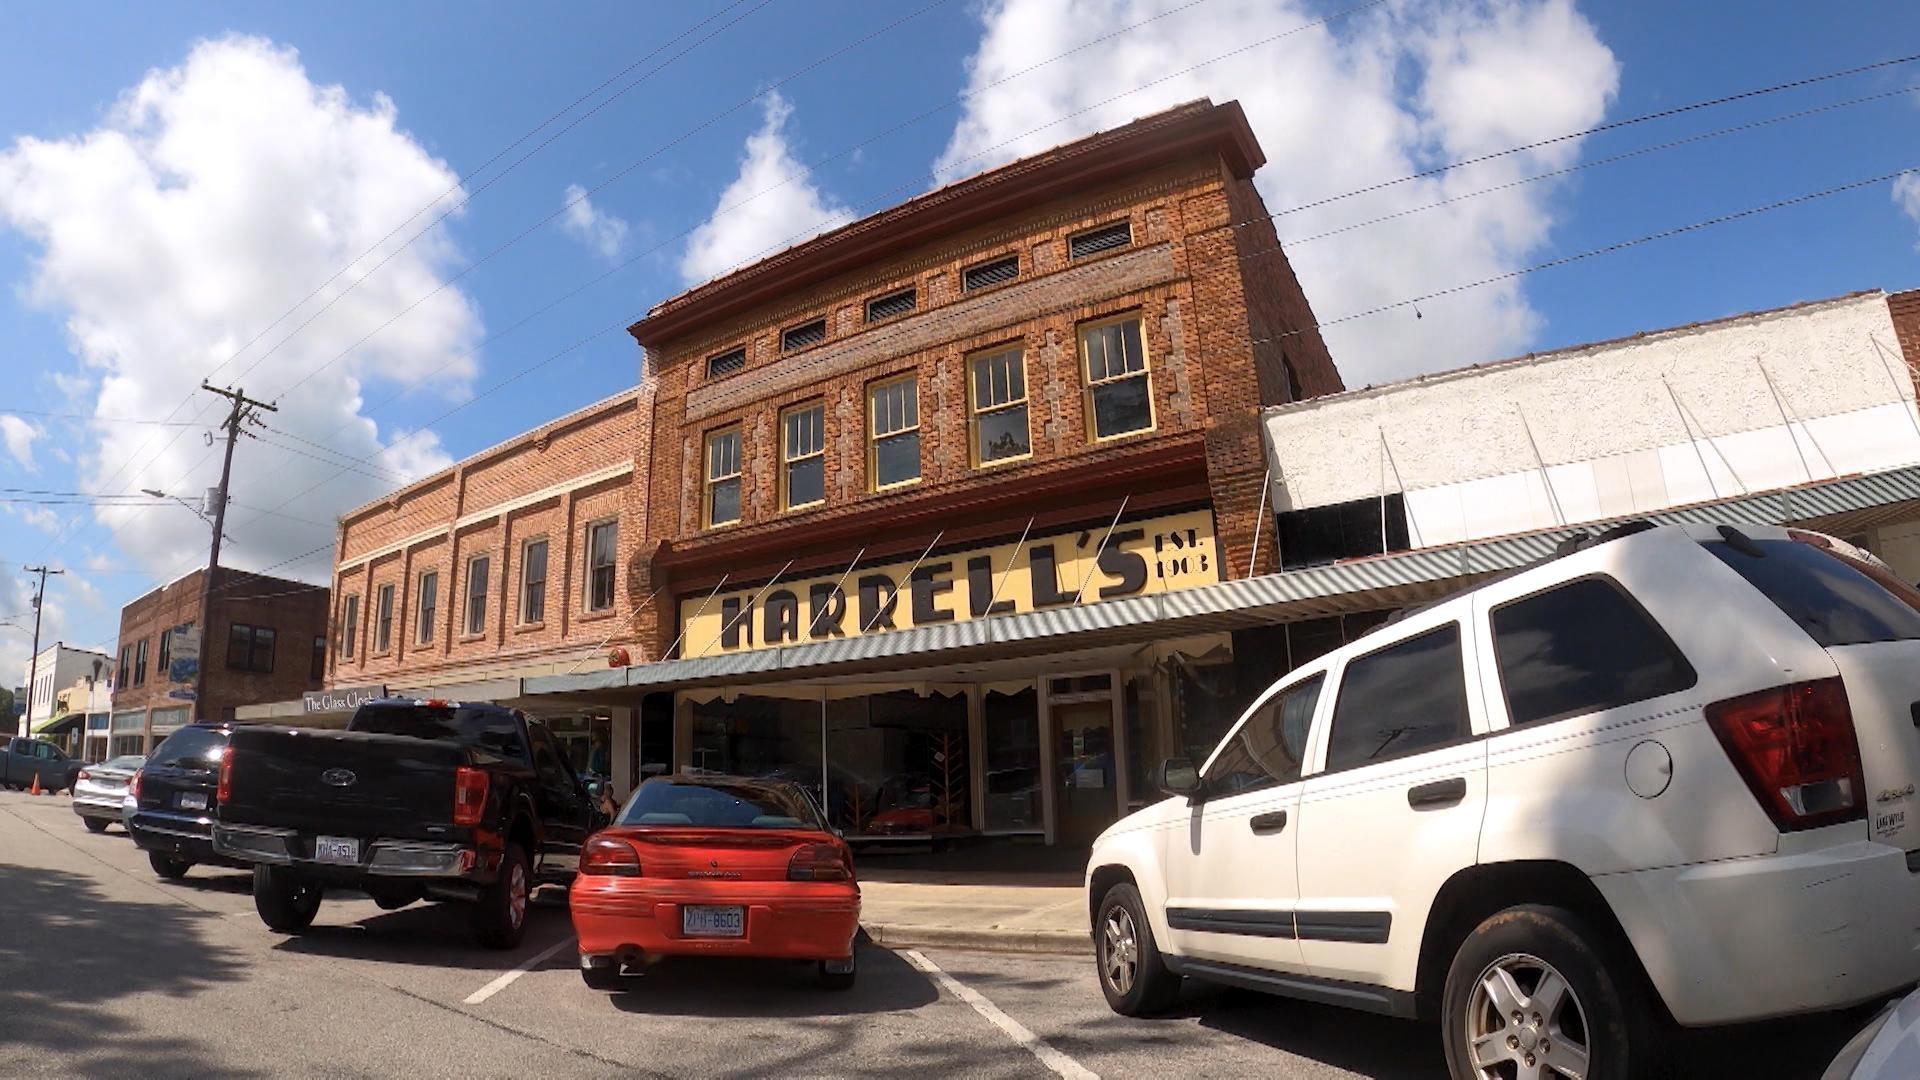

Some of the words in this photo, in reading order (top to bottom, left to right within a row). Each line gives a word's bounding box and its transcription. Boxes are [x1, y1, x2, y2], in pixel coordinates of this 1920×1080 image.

[1155, 527, 1203, 553] EST.
[1156, 554, 1208, 578] 1903
[721, 528, 1148, 650] HARRELL'S
[305, 696, 321, 712] The
[322, 693, 346, 710] Glass
